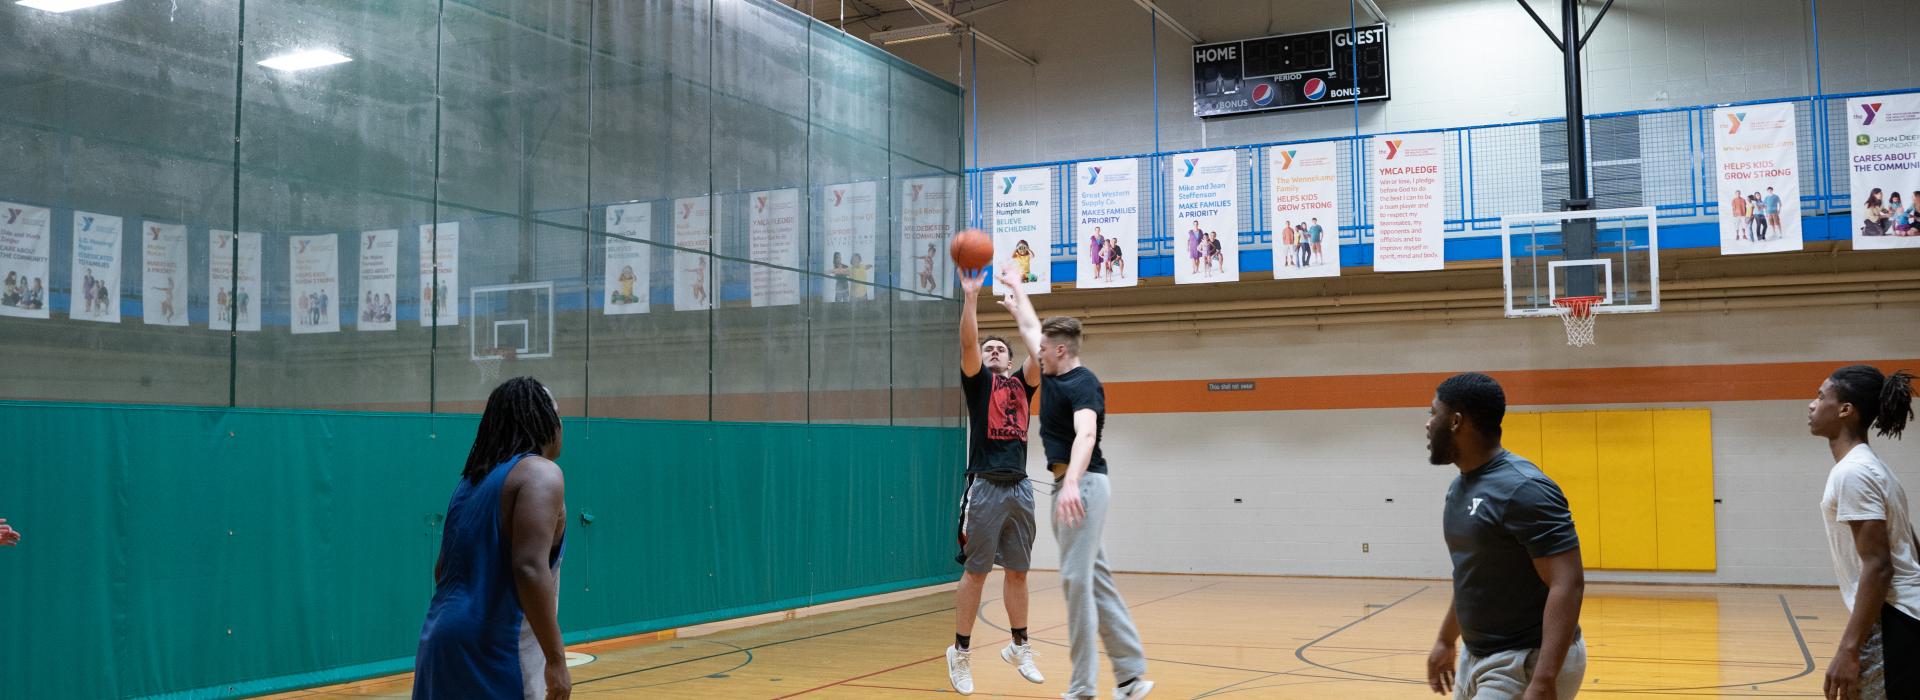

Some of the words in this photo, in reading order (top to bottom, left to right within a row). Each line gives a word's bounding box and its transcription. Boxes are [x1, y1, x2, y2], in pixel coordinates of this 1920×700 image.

[1196, 47, 1236, 63] HOME
[1335, 29, 1383, 47] GUEST
[1274, 73, 1302, 82] PERIOD
[1219, 99, 1248, 108] BONUS
[1330, 88, 1360, 98] BONUS
[1854, 155, 1882, 163] CARES
[1885, 152, 1917, 161] ABOUT
[1753, 160, 1774, 169] KIDS
[1406, 166, 1438, 174] PLEDGE
[1724, 172, 1751, 180] GROW
[1753, 169, 1791, 178] STRONG
[1025, 200, 1039, 208] Amy
[1301, 202, 1332, 210] STRONG
[996, 208, 1030, 216] Humphries
